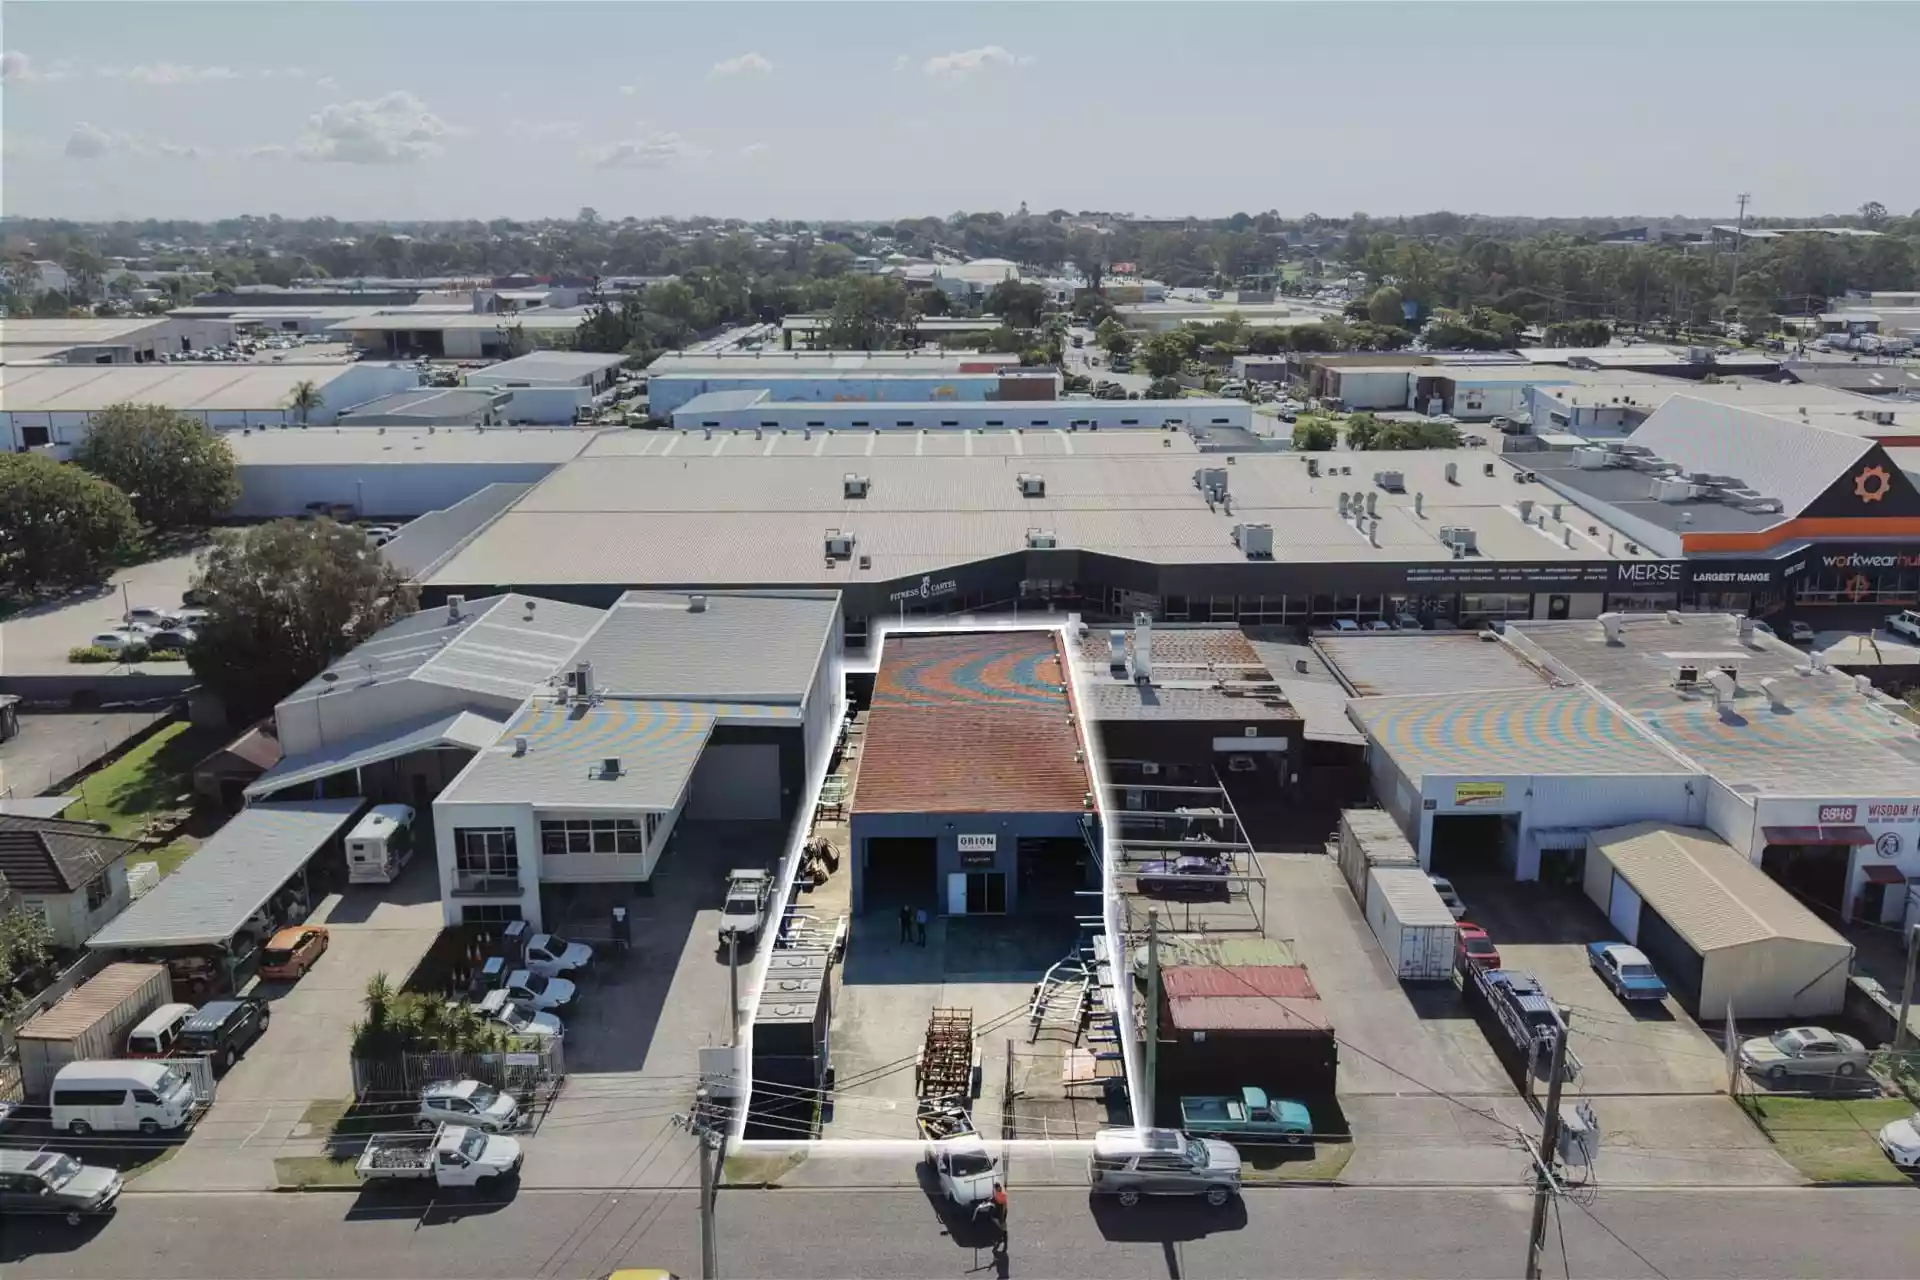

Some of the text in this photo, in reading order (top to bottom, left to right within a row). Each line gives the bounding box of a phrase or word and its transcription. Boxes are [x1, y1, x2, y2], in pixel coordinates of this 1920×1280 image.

[1618, 564, 1682, 580] MERSE
[1693, 572, 1770, 582] LARGEST RANGE
[890, 588, 919, 601] FITNESS
[1868, 804, 1908, 816] WISDOM
[961, 837, 993, 845] ORION
